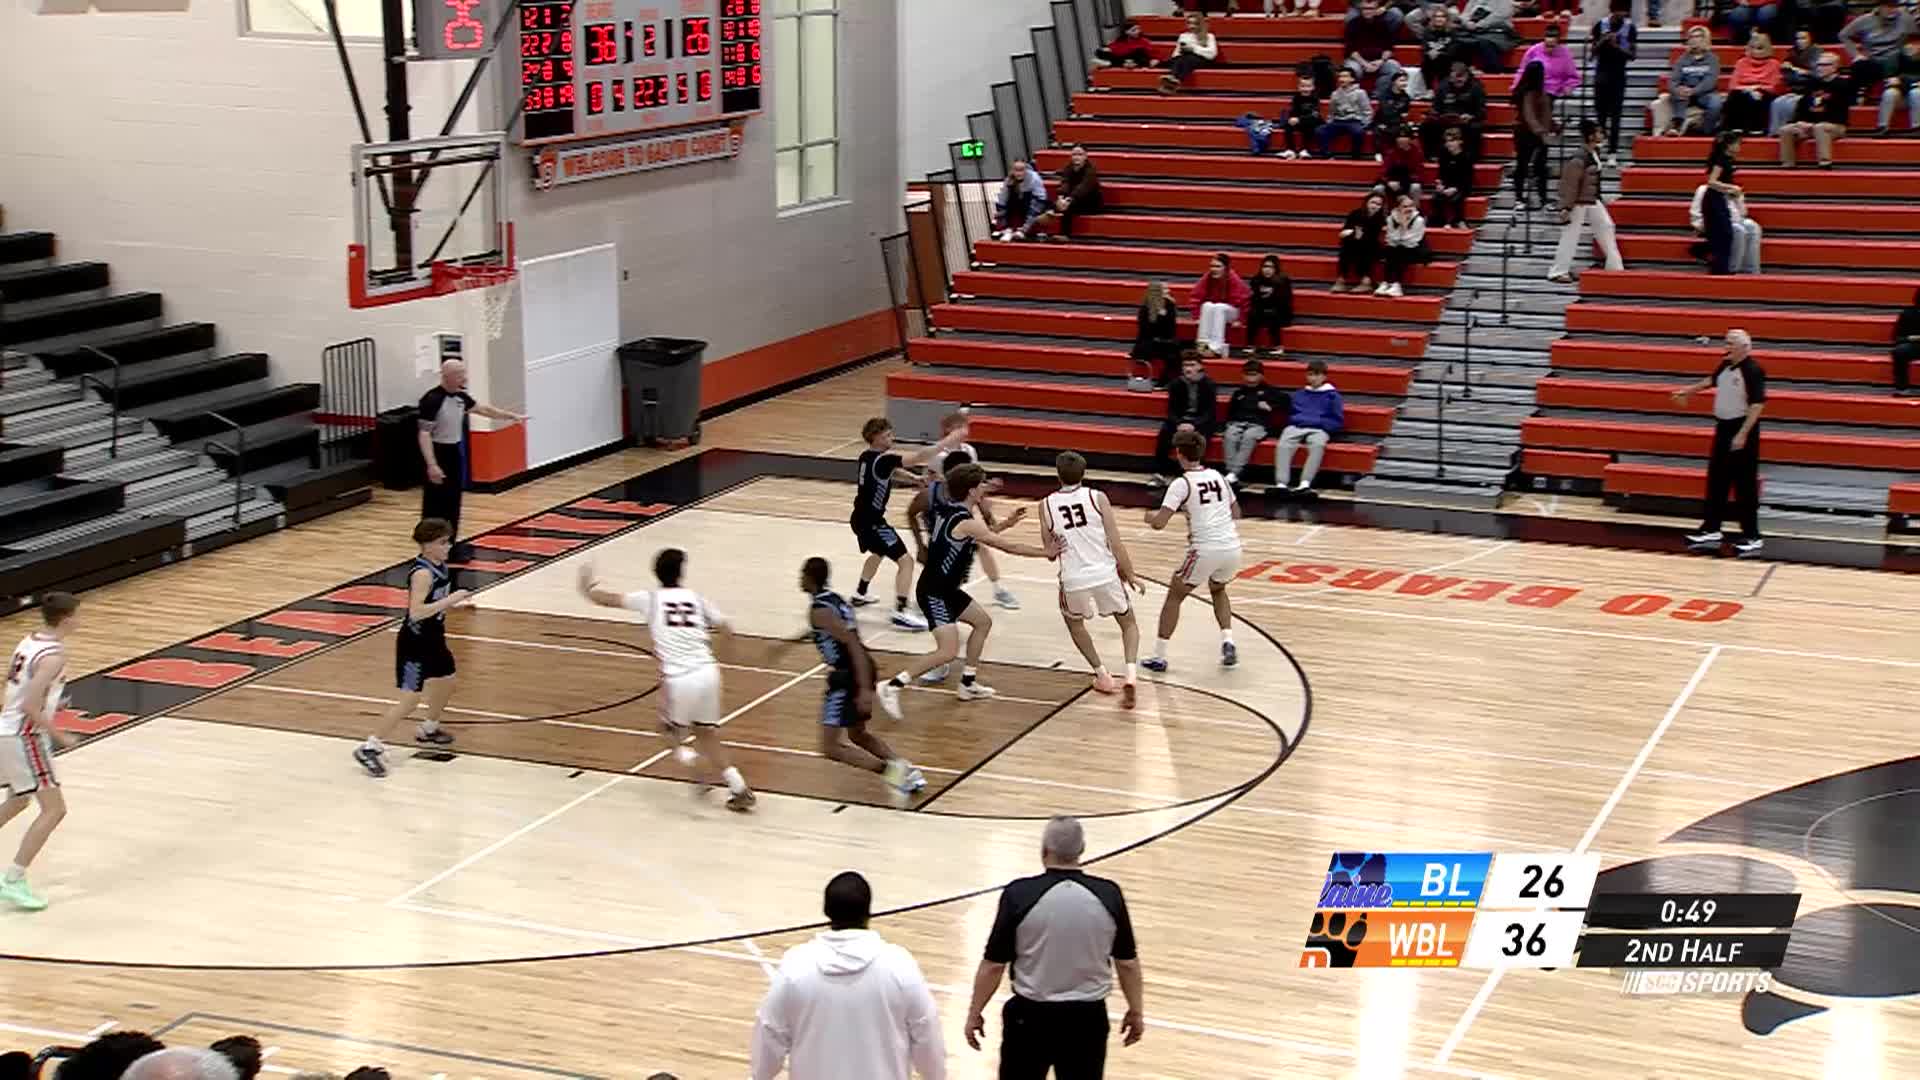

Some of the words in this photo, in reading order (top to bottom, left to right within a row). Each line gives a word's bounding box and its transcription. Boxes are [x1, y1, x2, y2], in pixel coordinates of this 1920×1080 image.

[590, 25, 617, 63] 36
[1197, 479, 1222, 504] 24
[1058, 503, 1088, 530] 33
[662, 601, 695, 627] 22
[1599, 594, 1745, 623] GO
